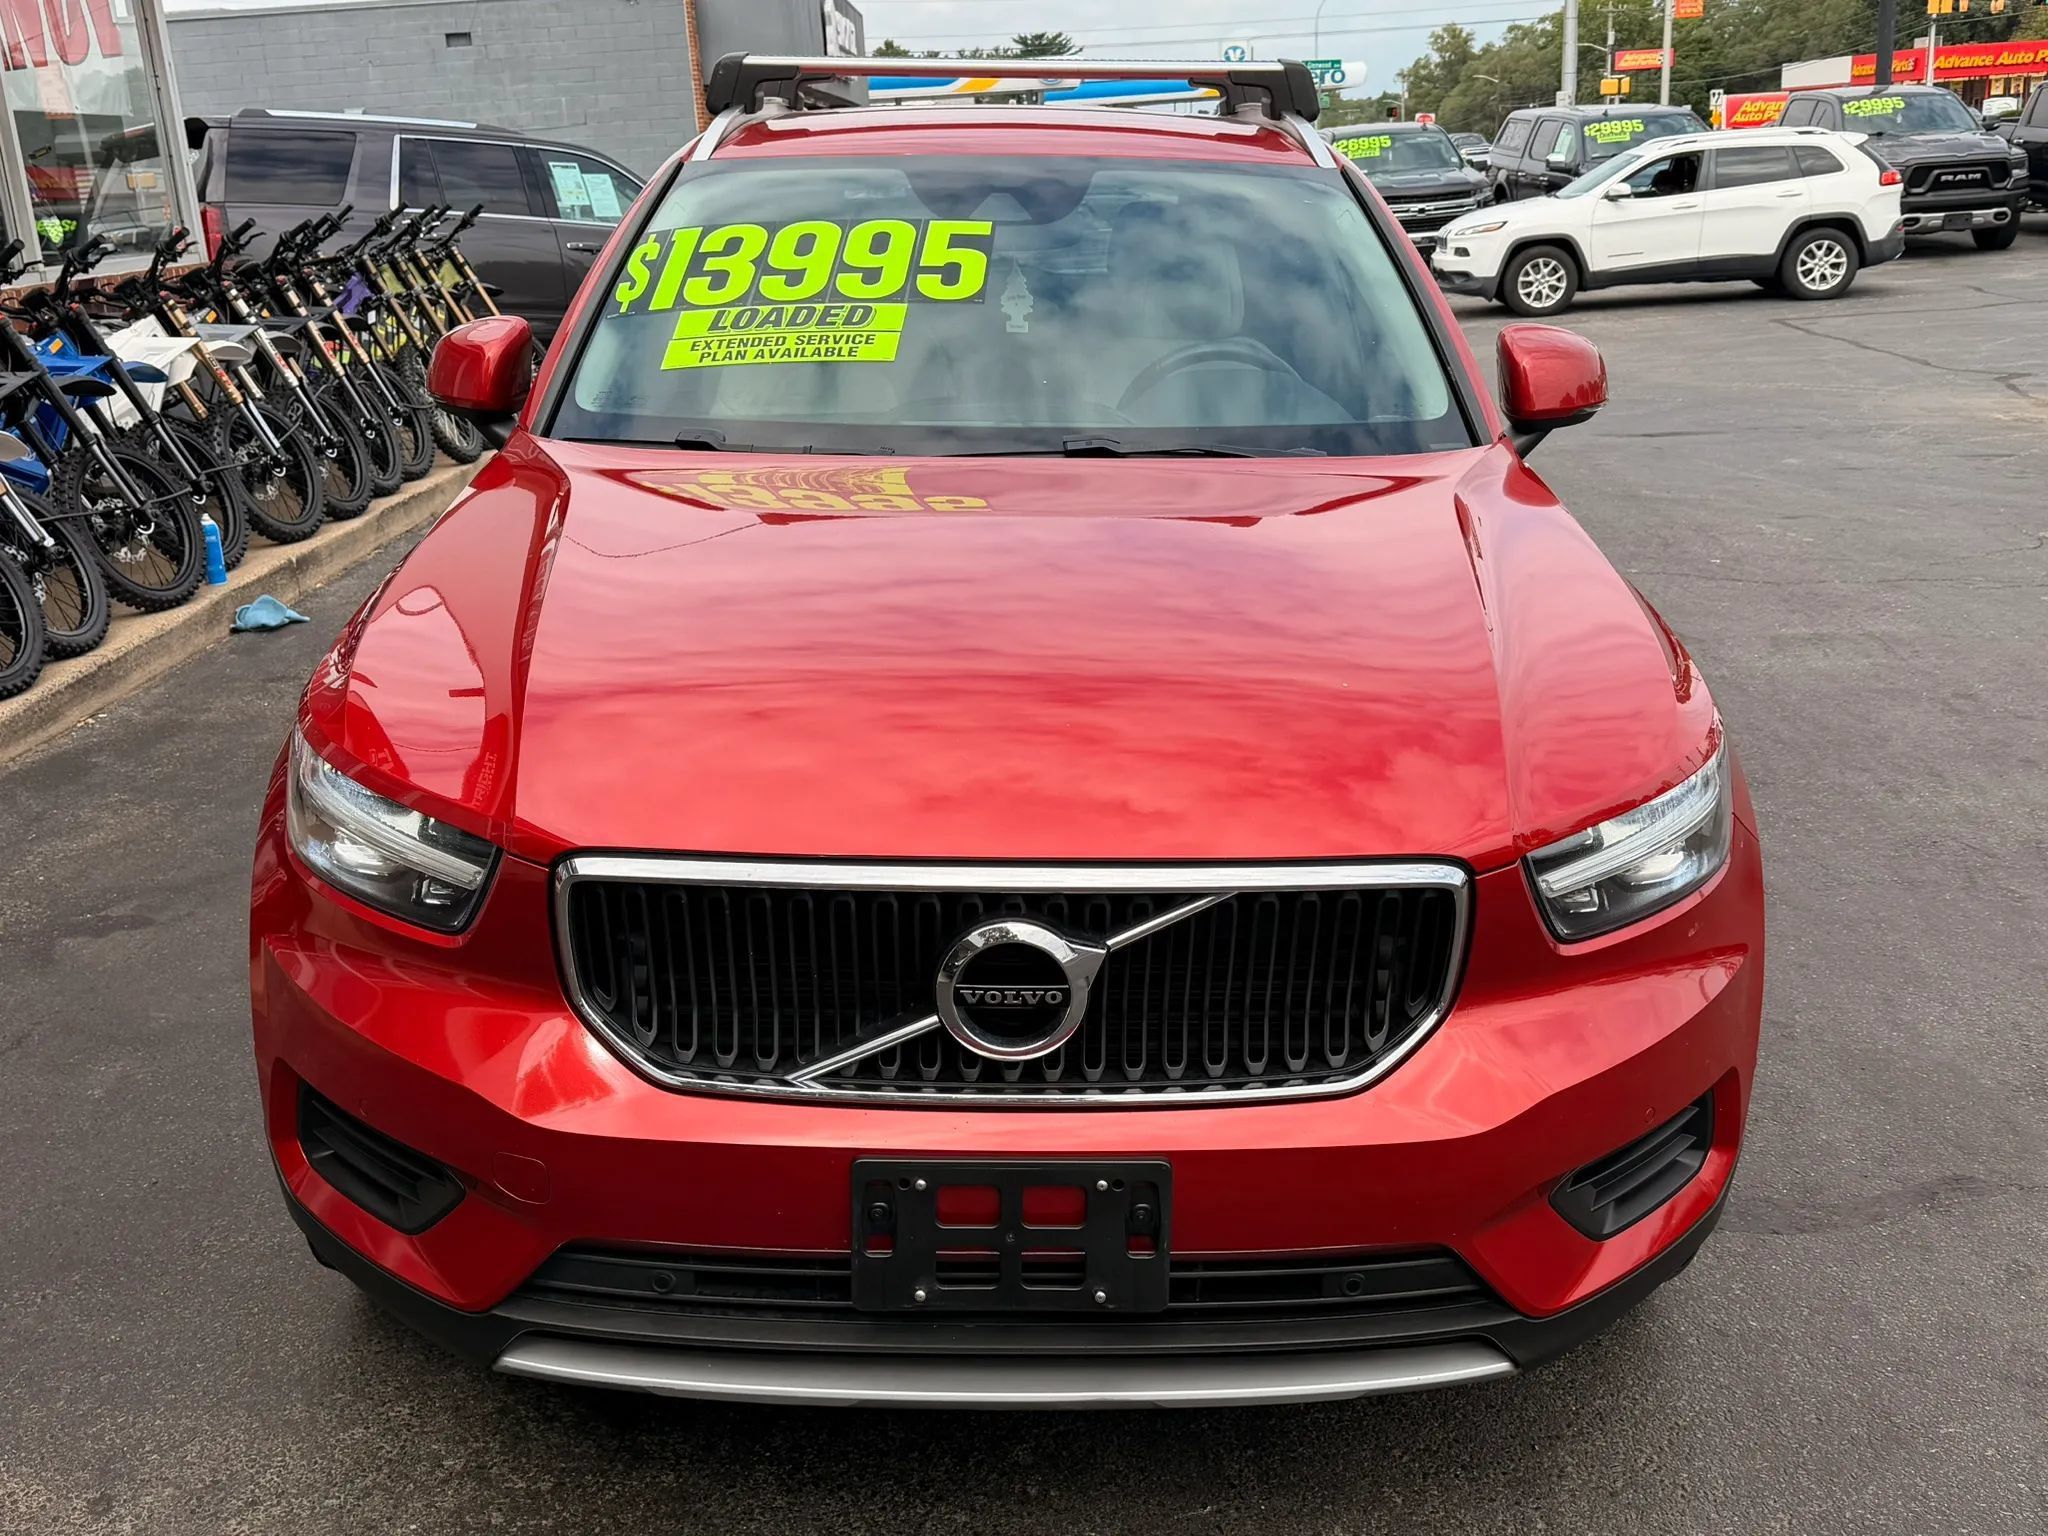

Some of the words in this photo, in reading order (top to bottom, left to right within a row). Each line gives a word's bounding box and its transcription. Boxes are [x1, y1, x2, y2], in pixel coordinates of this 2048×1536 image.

[1933, 54, 1994, 69] Advance
[1994, 51, 2035, 65] Auto
[1842, 96, 1906, 114] $29995
[1731, 111, 1763, 123] Auto
[1583, 119, 1645, 137] $29995
[1941, 173, 1982, 182] RAM
[614, 219, 993, 313] $13995
[706, 303, 879, 335] LOADED
[690, 336, 787, 353] EXTENDED
[795, 333, 876, 347] SERVICE
[699, 349, 747, 363] PLAN
[753, 345, 859, 360] AVAILABLE
[959, 990, 1063, 1005] VOLVO
